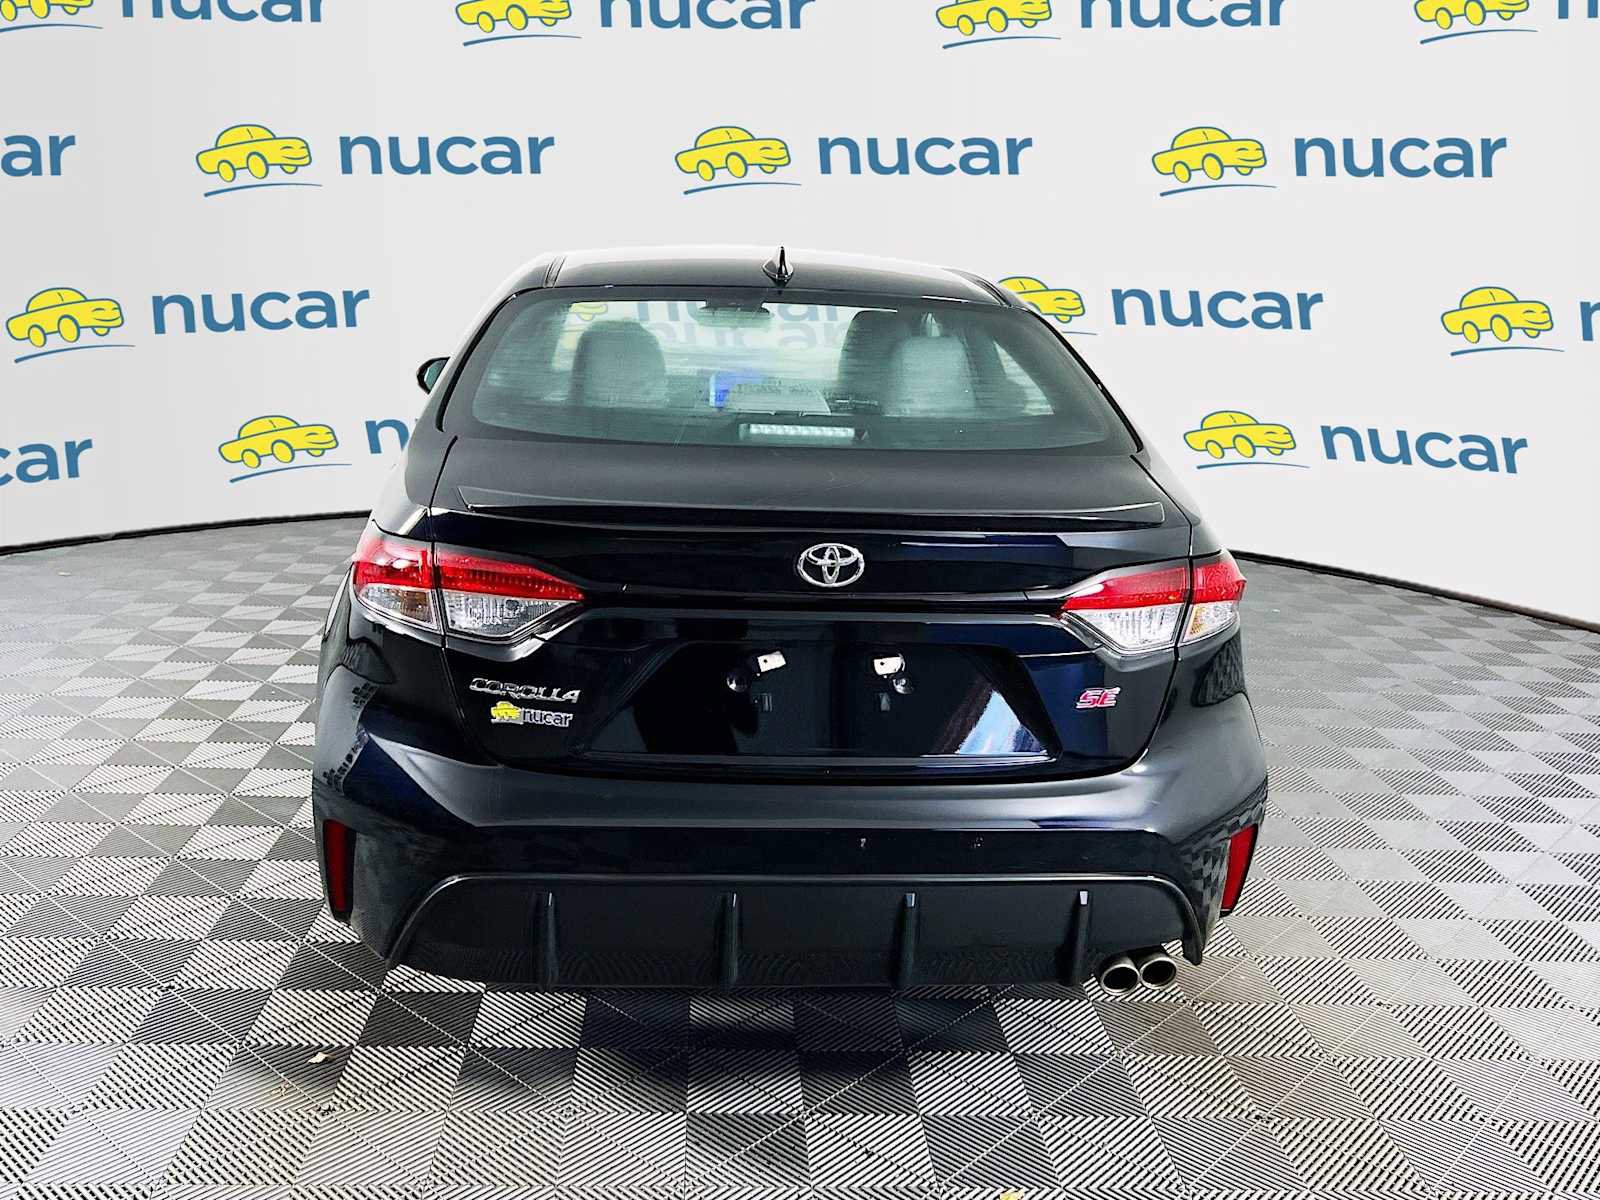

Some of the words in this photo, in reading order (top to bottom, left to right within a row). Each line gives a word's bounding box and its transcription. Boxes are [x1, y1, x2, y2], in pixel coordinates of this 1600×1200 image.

[600, 0, 816, 29] nucar
[1080, 0, 1284, 28] nucar
[339, 134, 555, 175] nucar
[818, 136, 1033, 176] nucar
[1294, 137, 1507, 178] nucar
[152, 289, 370, 335] nucar
[1111, 287, 1323, 331] nucar
[1320, 425, 1529, 475] nucar
[469, 677, 582, 704] COROLLA
[1076, 686, 1121, 709] SE
[522, 707, 574, 728] nucar
